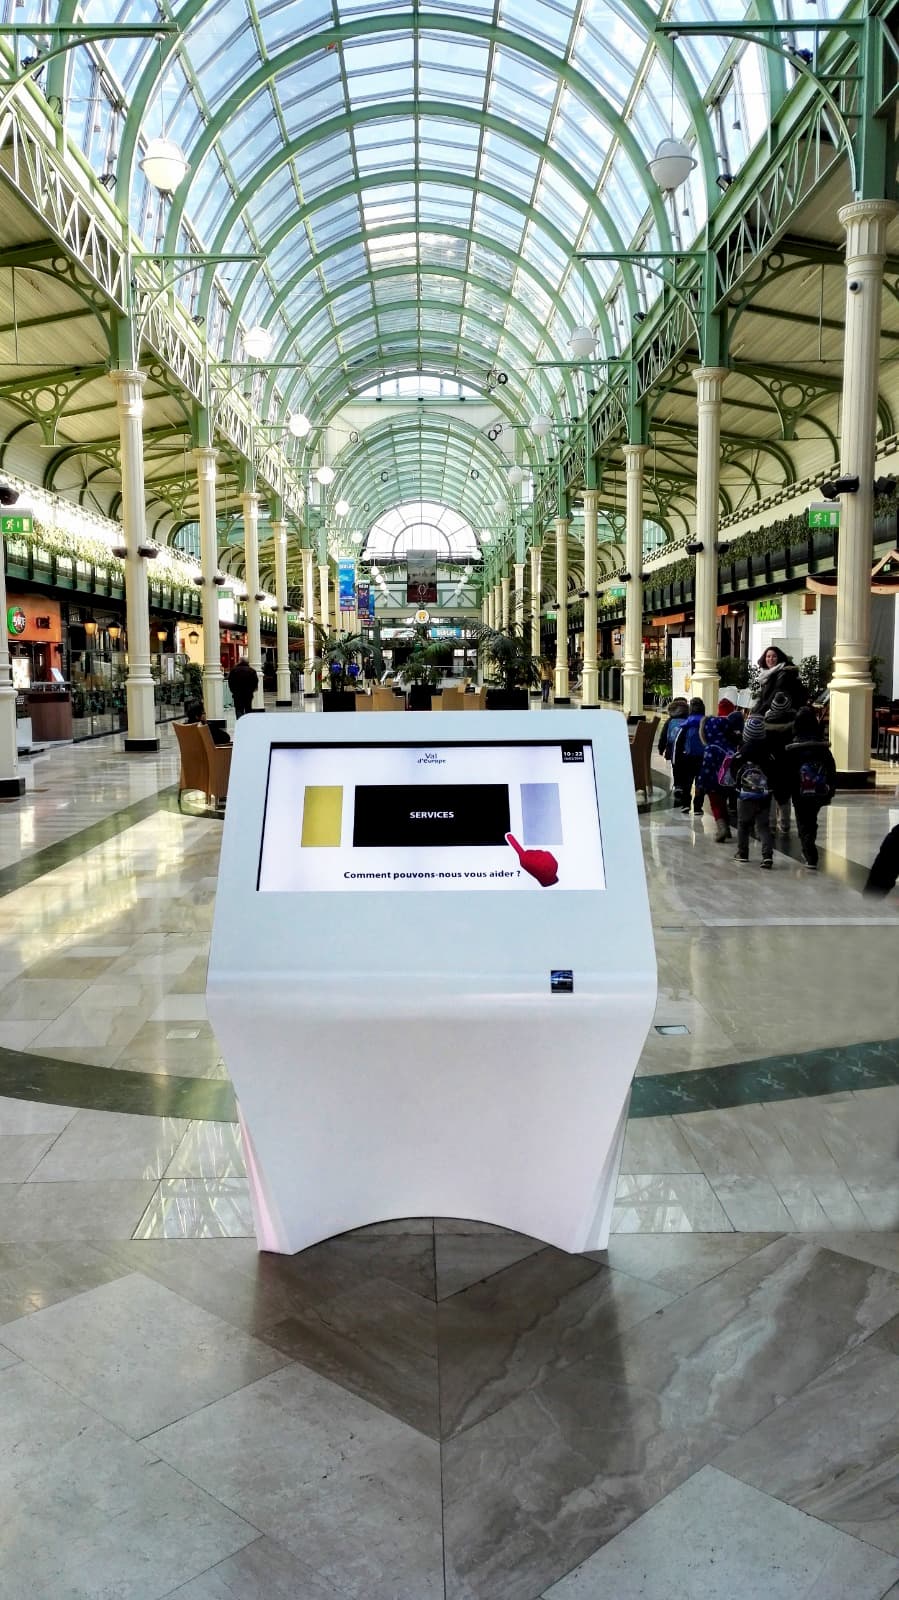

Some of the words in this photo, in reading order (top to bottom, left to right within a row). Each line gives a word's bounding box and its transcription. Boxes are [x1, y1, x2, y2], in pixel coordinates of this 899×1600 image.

[409, 811, 455, 819] SERVICES
[343, 871, 391, 879] Comment
[393, 870, 462, 880] pouvons-nous
[489, 870, 514, 878] aider
